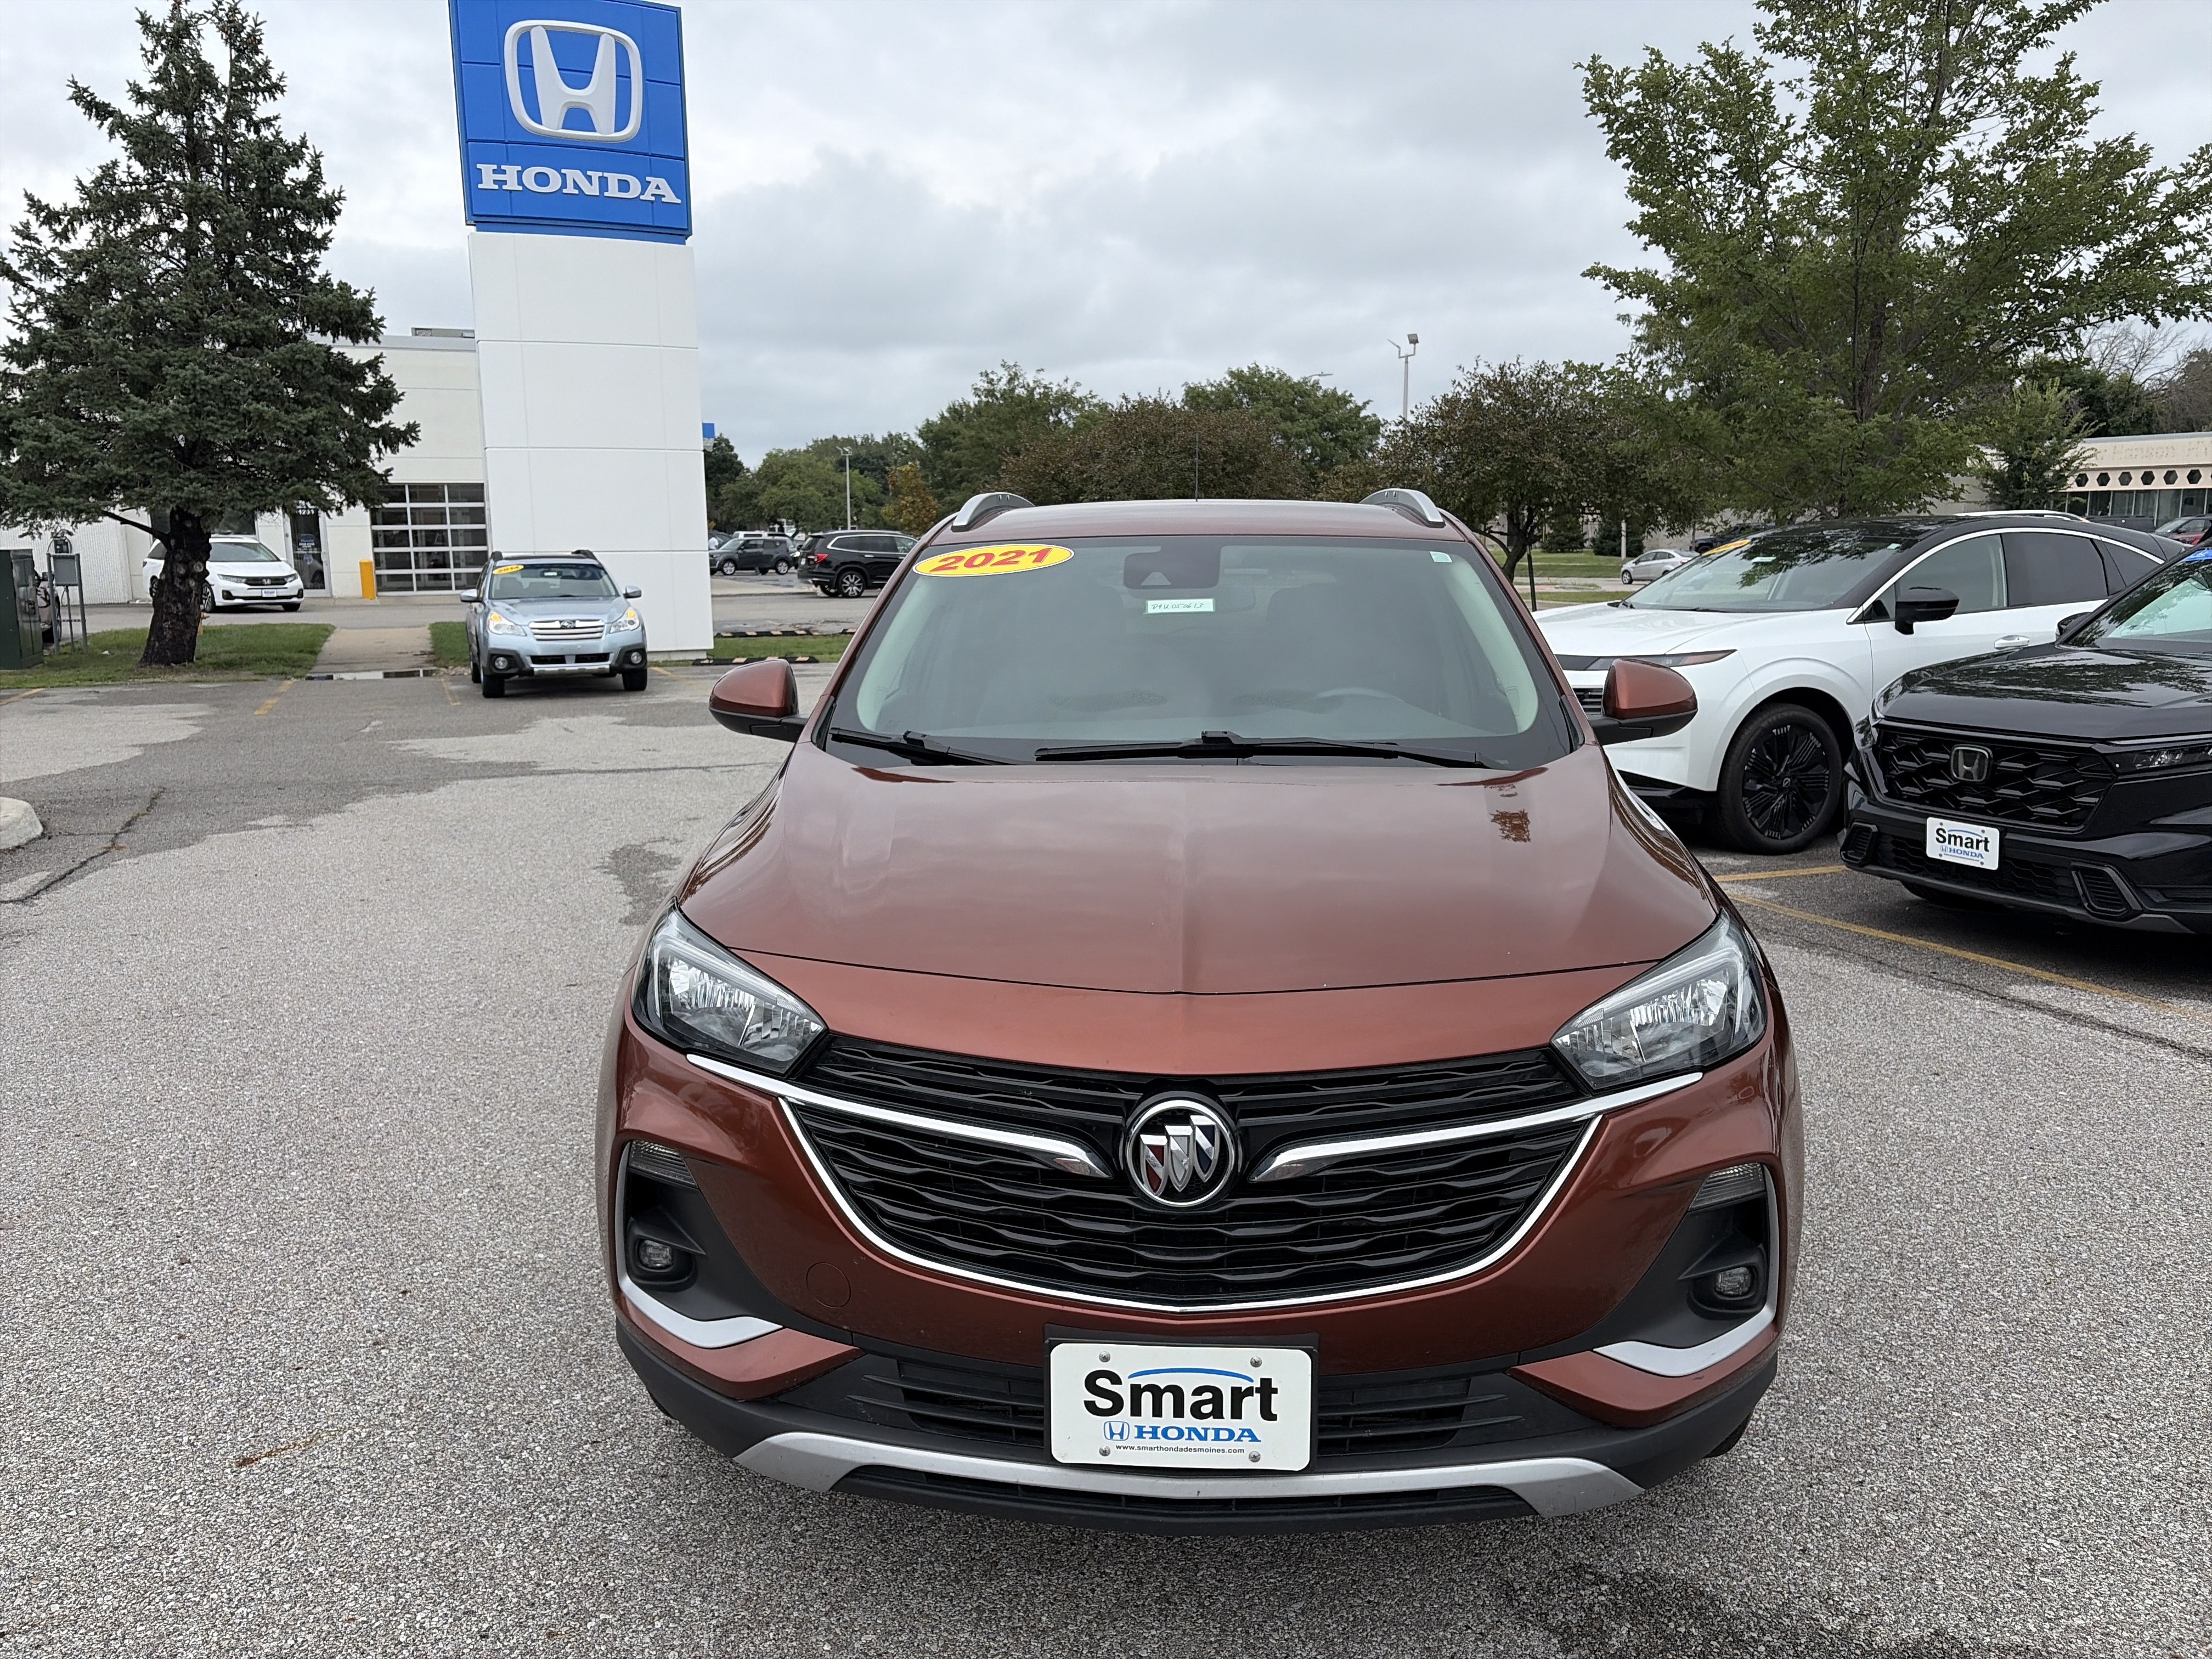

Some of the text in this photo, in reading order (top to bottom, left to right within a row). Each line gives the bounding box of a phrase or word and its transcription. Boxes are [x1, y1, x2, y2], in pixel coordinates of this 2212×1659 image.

[476, 163, 681, 204] HONDA
[929, 548, 1053, 572] 2021
[1936, 828, 1990, 853] Smart
[1949, 847, 1984, 859] HONDA
[1083, 1369, 1278, 1421] Smart
[1134, 1425, 1261, 1442] HONDA
[1115, 1444, 1245, 1454] www.smarthondadesmoines.com
